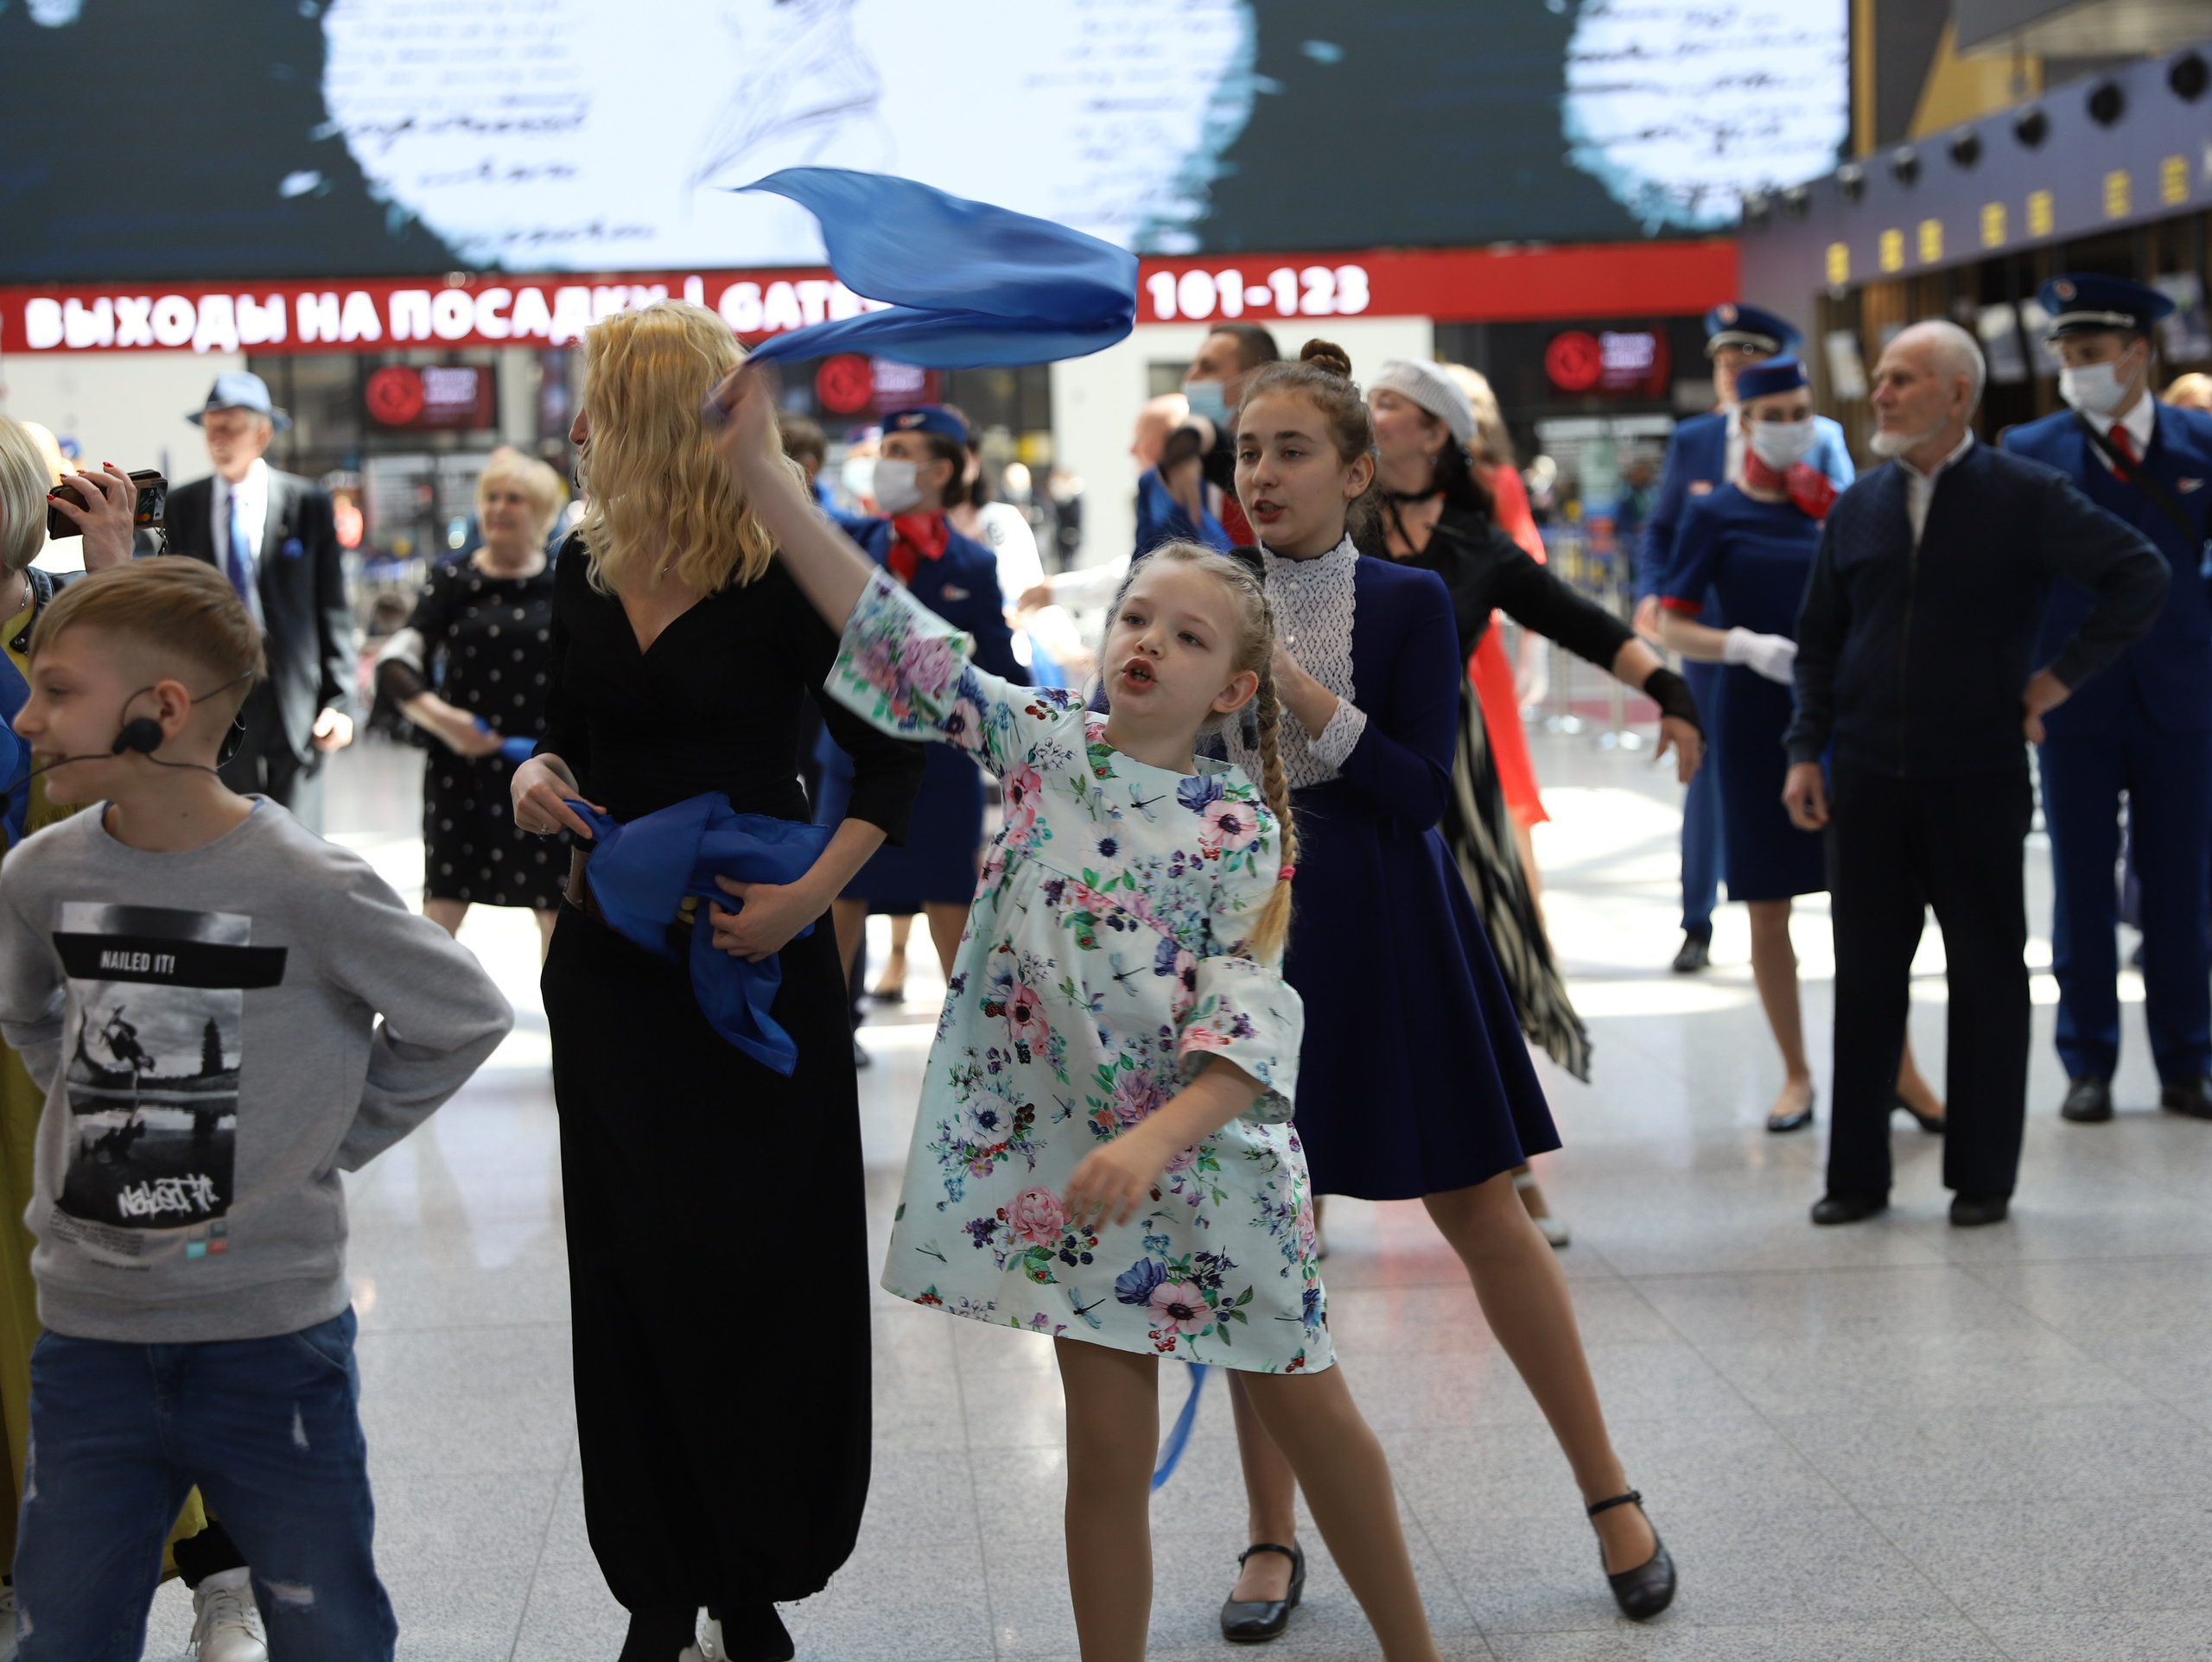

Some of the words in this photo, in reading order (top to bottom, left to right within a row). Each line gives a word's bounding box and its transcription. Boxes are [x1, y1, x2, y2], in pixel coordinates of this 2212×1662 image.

[1146, 264, 1370, 320] 101-123
[25, 295, 288, 353] ВЫХОДЫ
[296, 290, 382, 343] НА
[100, 950, 150, 972] NAILED
[154, 954, 175, 975] IT!
